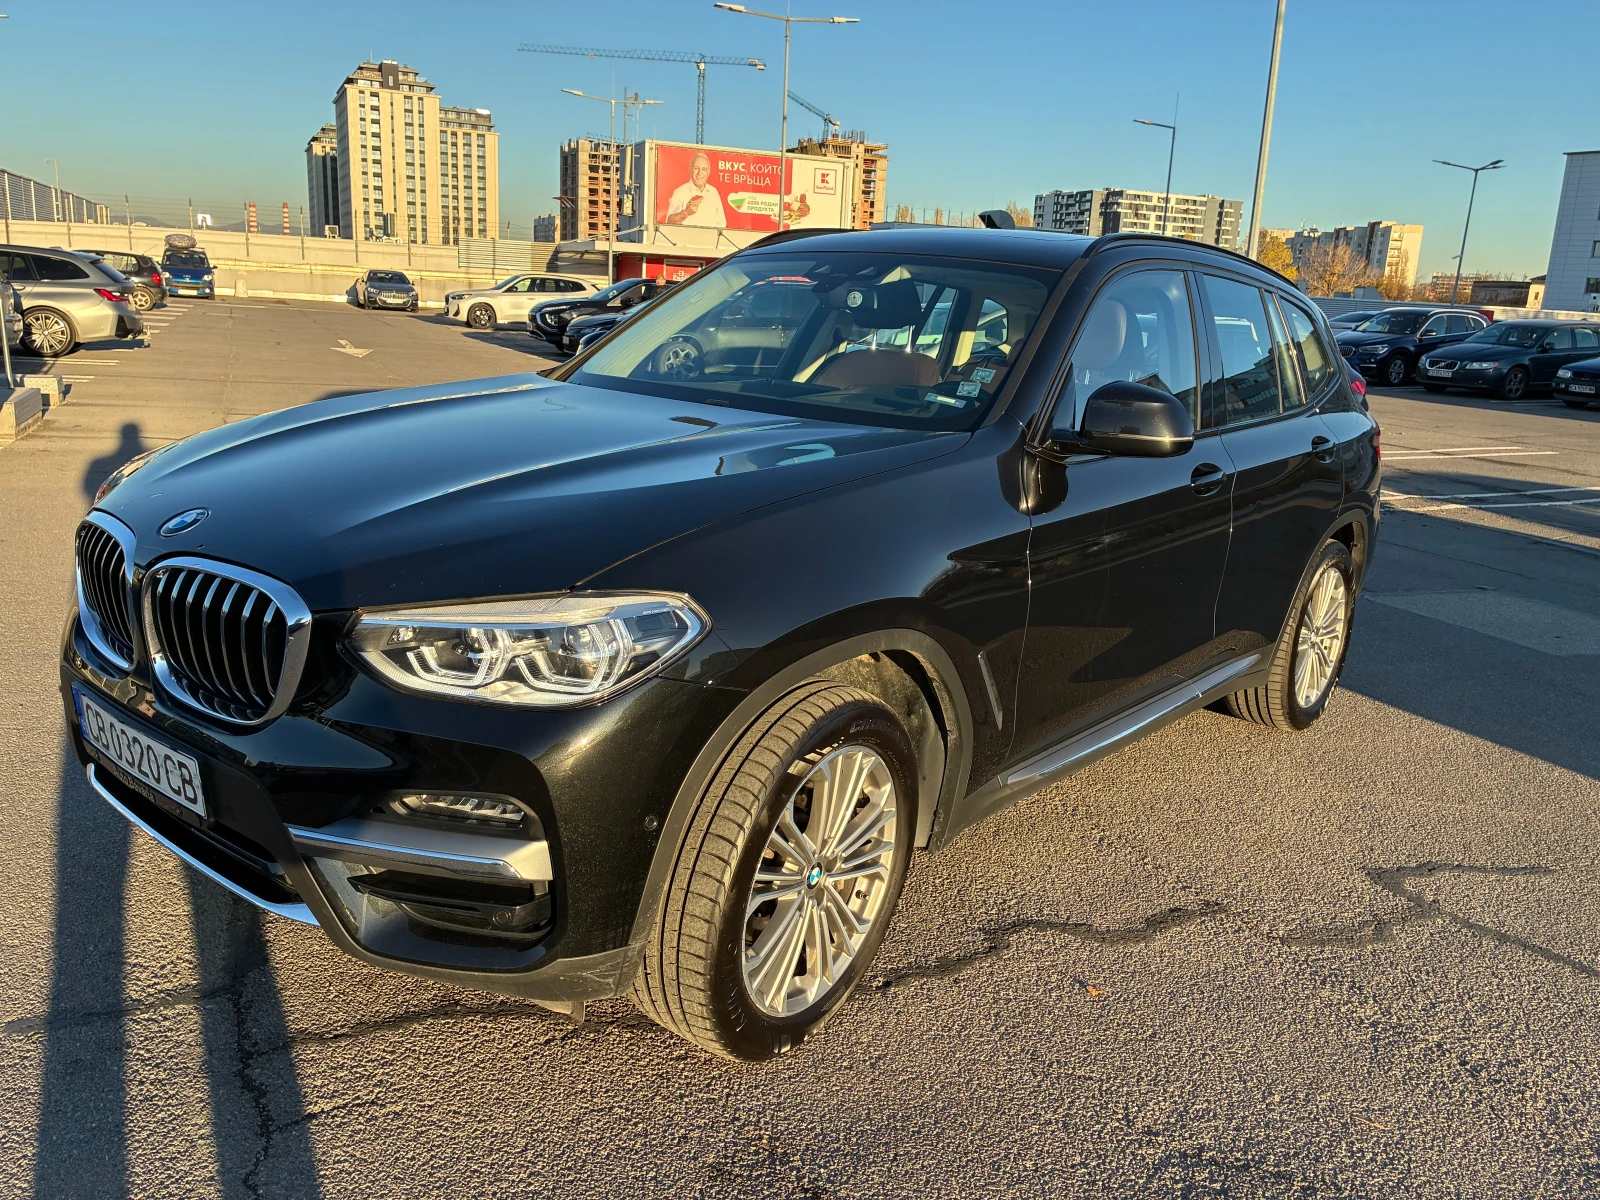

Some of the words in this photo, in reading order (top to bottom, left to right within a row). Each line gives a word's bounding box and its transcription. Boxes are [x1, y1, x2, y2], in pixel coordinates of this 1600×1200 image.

[718, 160, 748, 173] ВКУС,
[718, 172, 731, 183] ТЕ
[733, 173, 771, 187] ВРЪЩА
